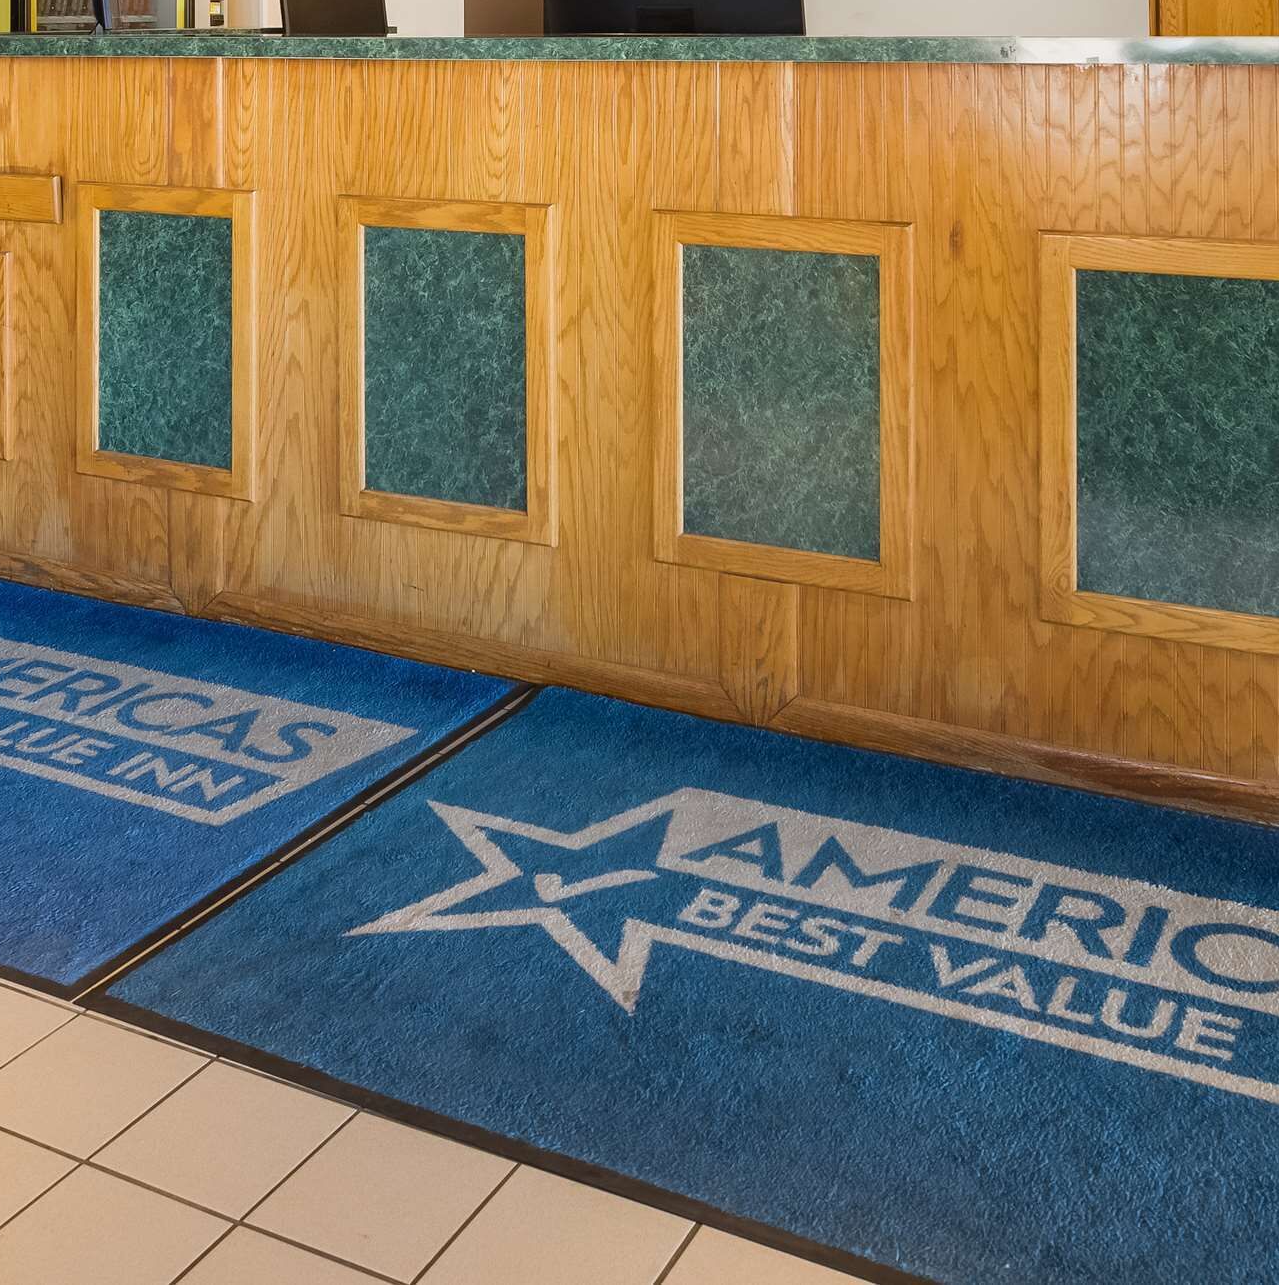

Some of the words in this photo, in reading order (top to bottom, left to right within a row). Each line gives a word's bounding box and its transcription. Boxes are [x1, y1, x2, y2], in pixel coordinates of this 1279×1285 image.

[108, 751, 246, 802] INN
[678, 887, 904, 967] BEST
[930, 942, 1245, 1062] VALUE
